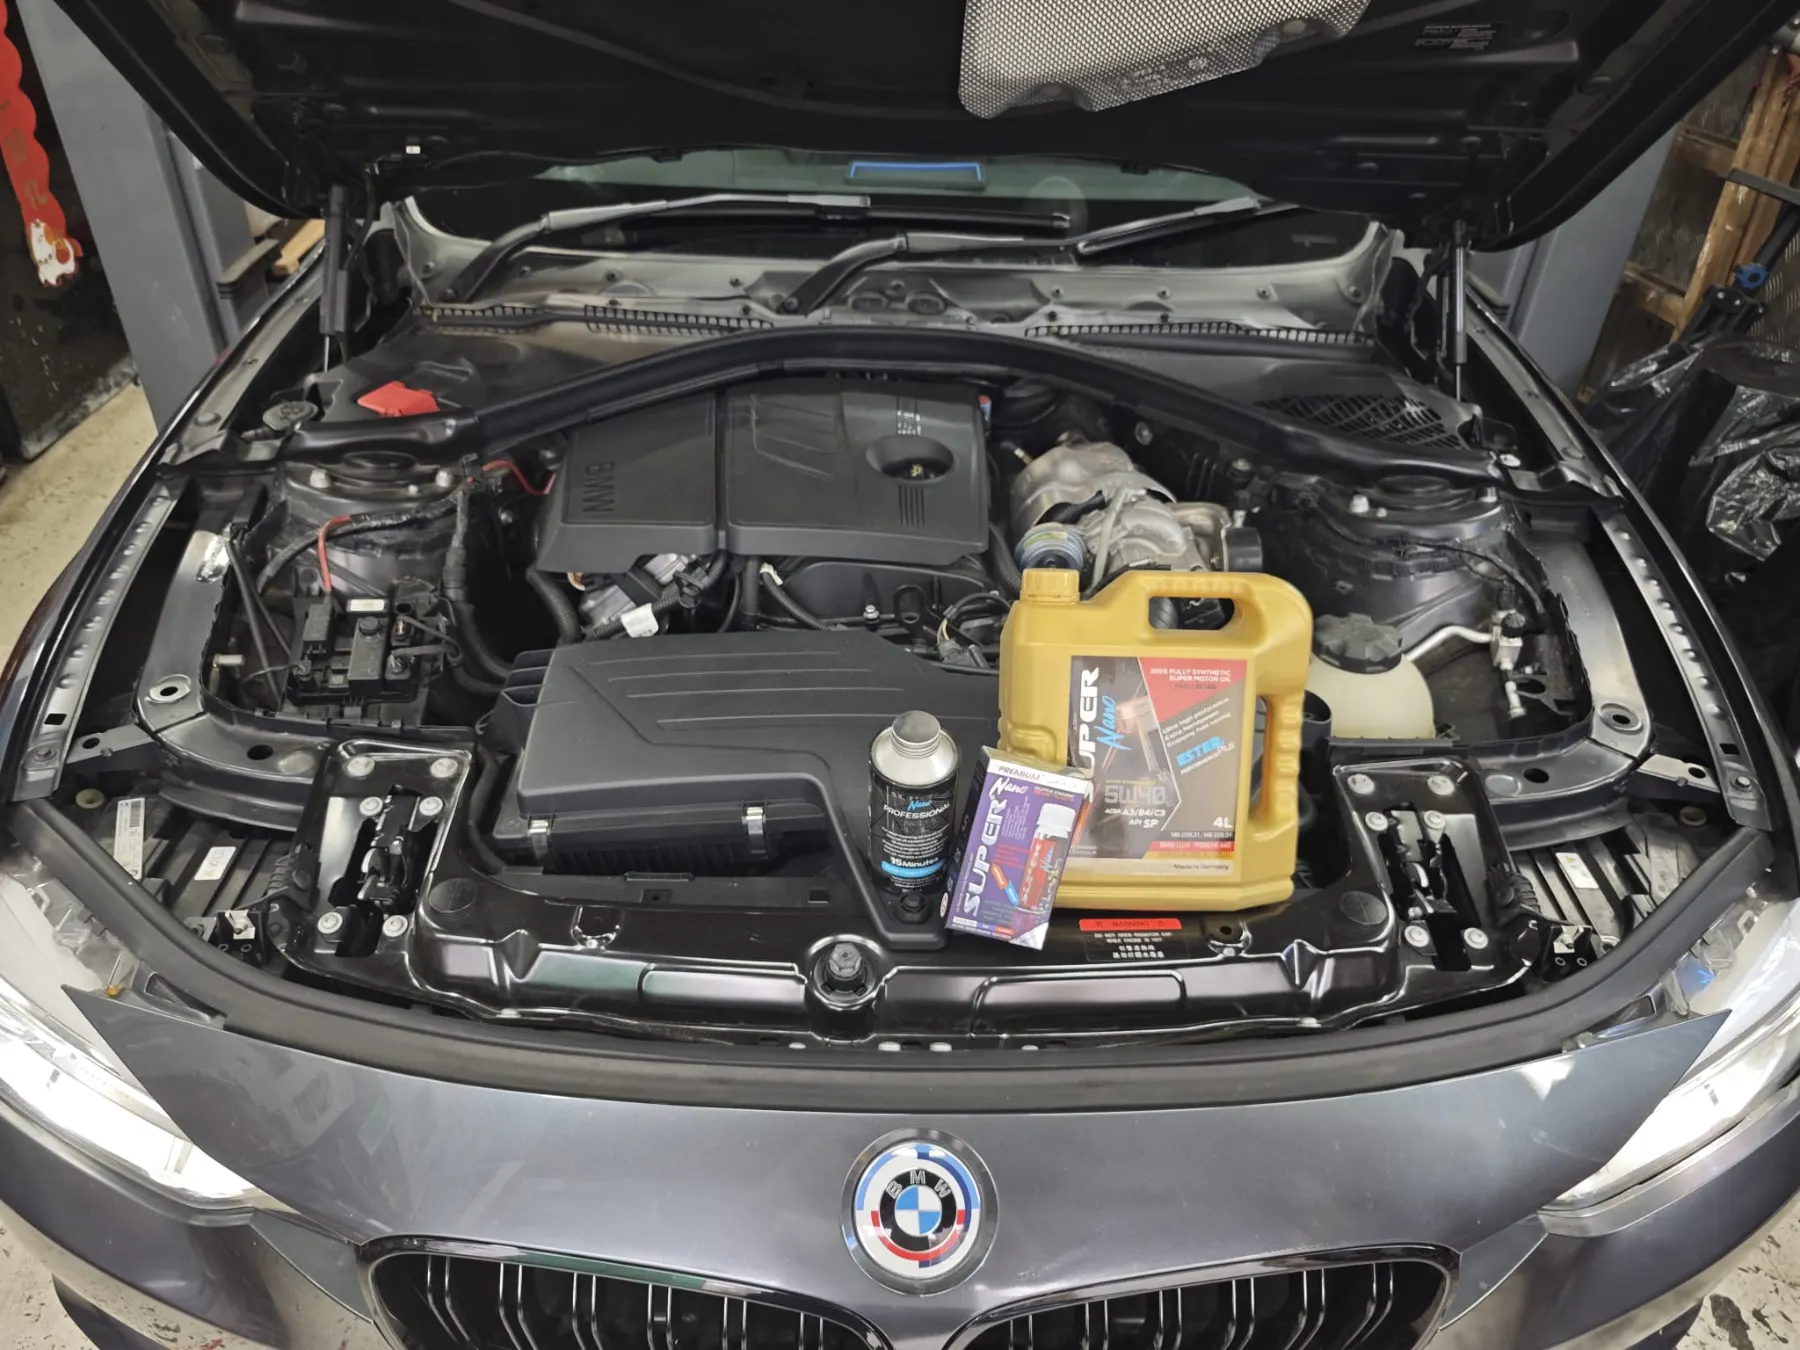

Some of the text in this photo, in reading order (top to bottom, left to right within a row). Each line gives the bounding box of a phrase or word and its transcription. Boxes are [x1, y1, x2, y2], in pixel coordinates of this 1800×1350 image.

[1169, 668, 1191, 676] FULLY
[1094, 695, 1132, 750] Nano
[998, 765, 1041, 781] PREMIUM
[989, 777, 1029, 796] Nano
[883, 801, 951, 819] PROFESSIONAL
[1129, 818, 1159, 829] API SP
[1213, 816, 1233, 829] 4L
[963, 795, 1008, 918] SUPER
[1111, 919, 1150, 927] WARNING
[885, 1169, 951, 1200] BMW
